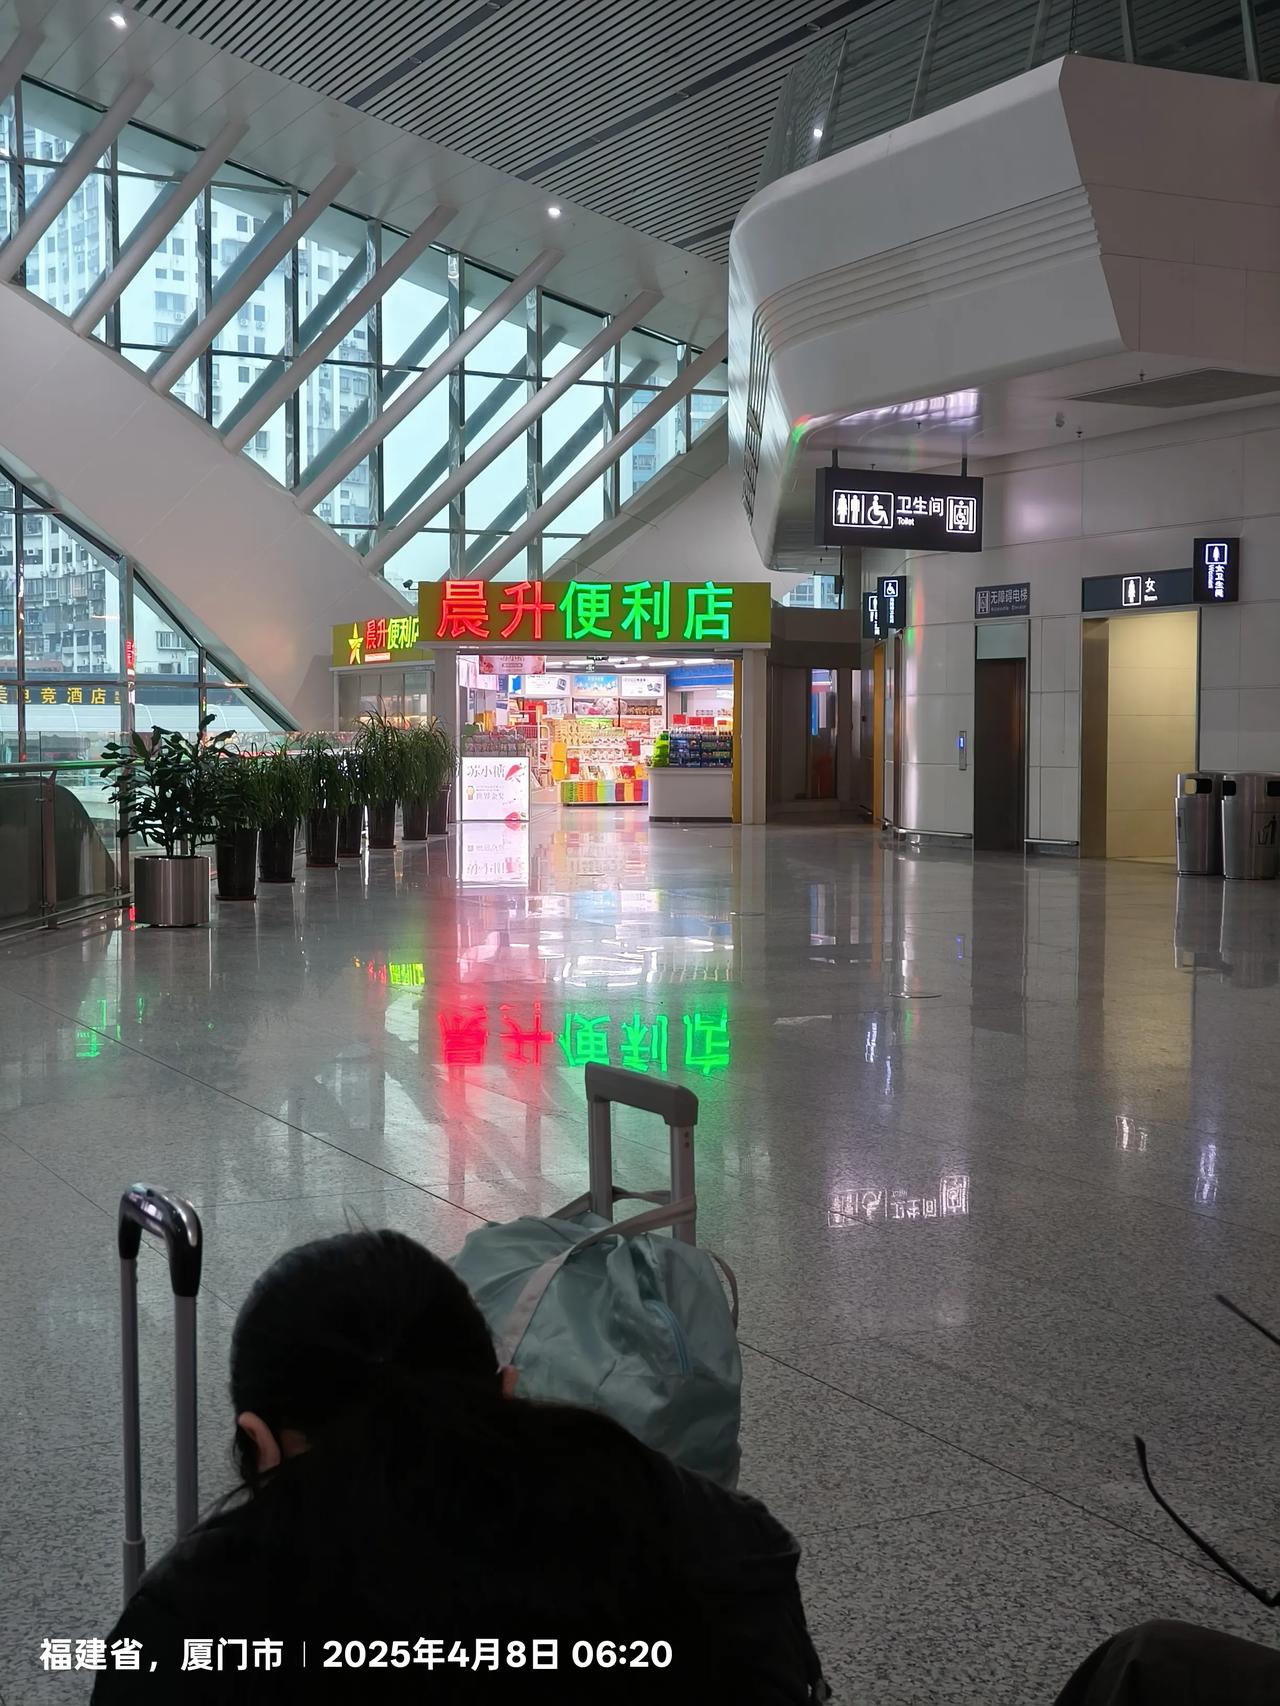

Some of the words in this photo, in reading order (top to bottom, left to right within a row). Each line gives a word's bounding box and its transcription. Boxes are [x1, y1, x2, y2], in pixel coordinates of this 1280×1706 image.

[896, 495, 944, 517] 卫生间
[897, 516, 915, 526] Toilet
[1144, 577, 1156, 593] 女
[436, 579, 734, 641] 晨升便利店
